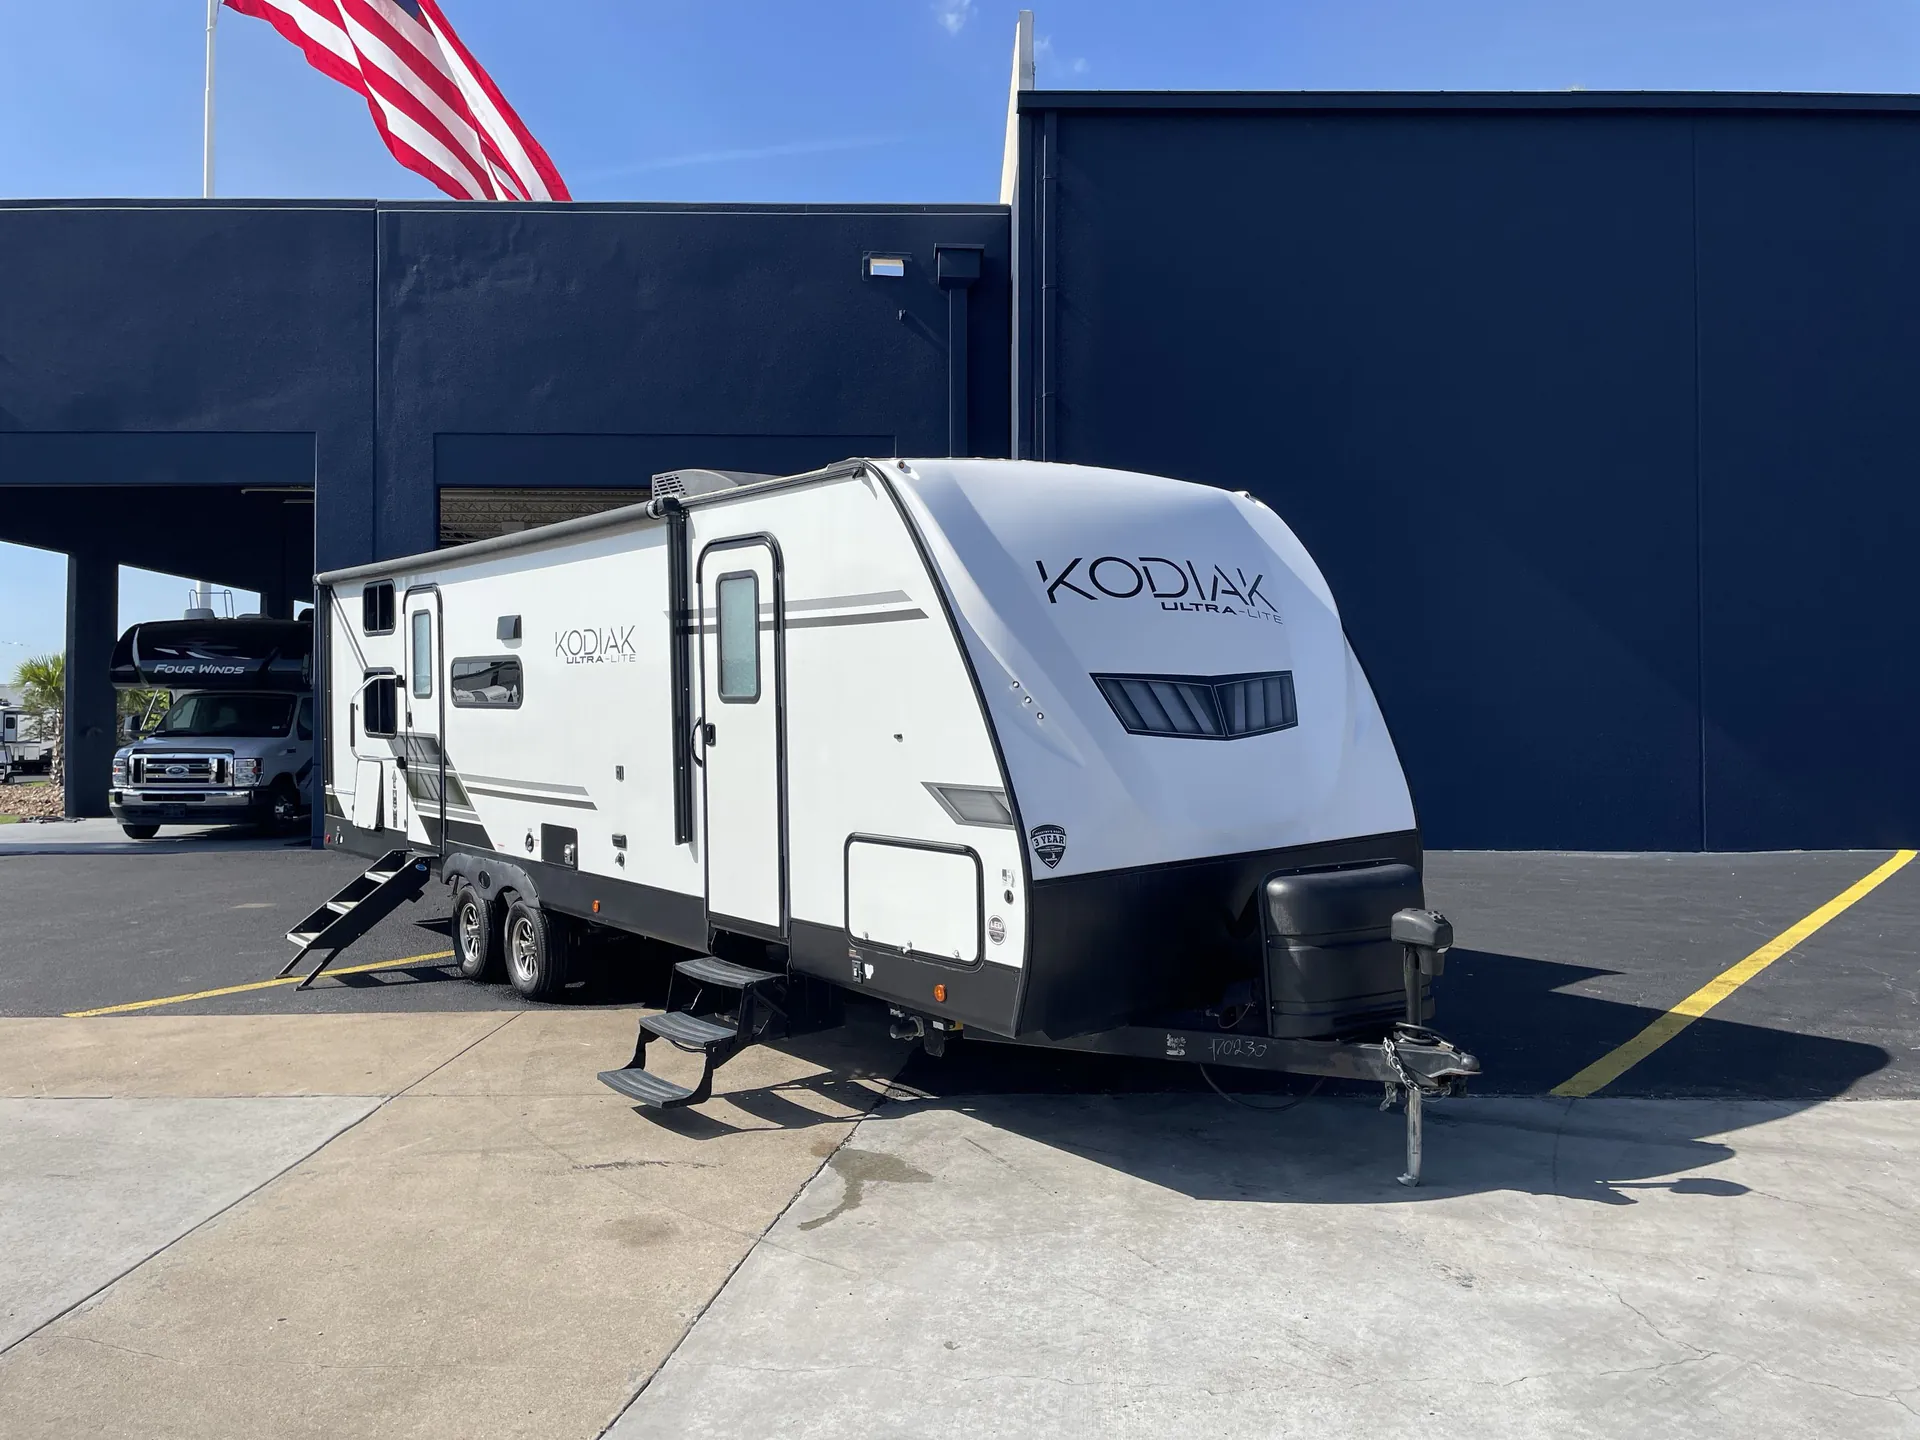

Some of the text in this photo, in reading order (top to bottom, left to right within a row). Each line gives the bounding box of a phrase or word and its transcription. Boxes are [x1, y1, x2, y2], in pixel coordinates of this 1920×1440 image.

[1035, 556, 1278, 613] KODIAK
[1161, 601, 1284, 625] ULTRA-LITE
[555, 625, 636, 657] KODIAK
[566, 653, 636, 664] ULTRA-LITE
[1033, 835, 1064, 847] 3 YEAR
